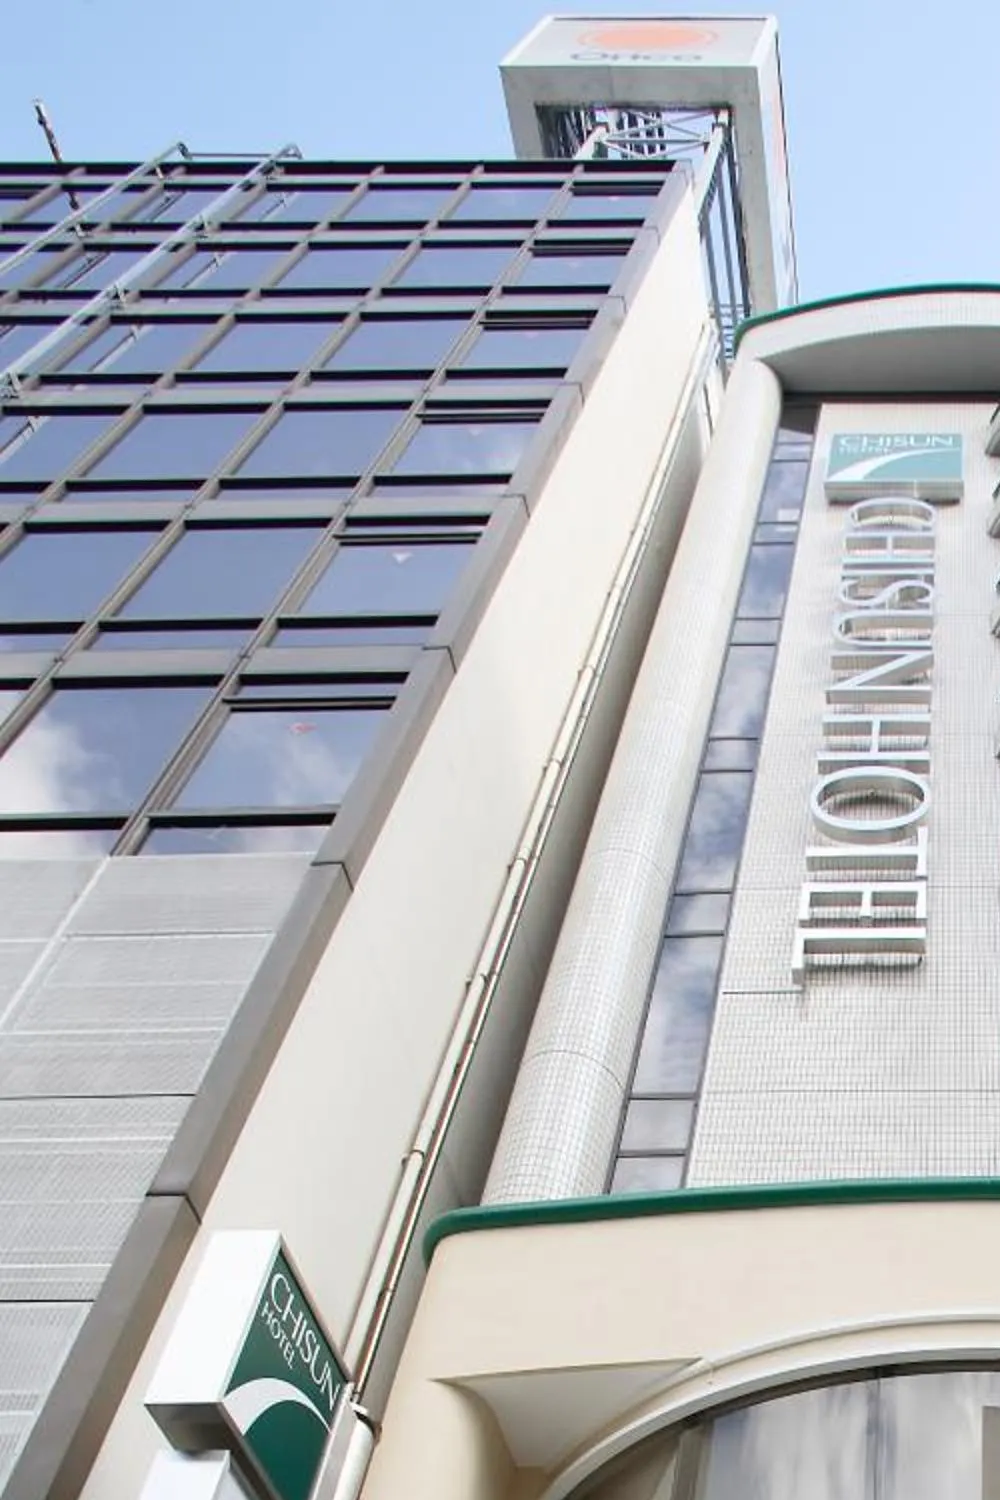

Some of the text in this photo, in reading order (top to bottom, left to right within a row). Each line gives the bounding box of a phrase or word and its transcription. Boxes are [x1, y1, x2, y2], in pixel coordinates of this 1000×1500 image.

[839, 435, 954, 447] CHISUN
[792, 497, 936, 972] CHISUN HOTEL
[261, 1301, 295, 1370] HOTEL
[271, 1273, 341, 1411] CHISUN
